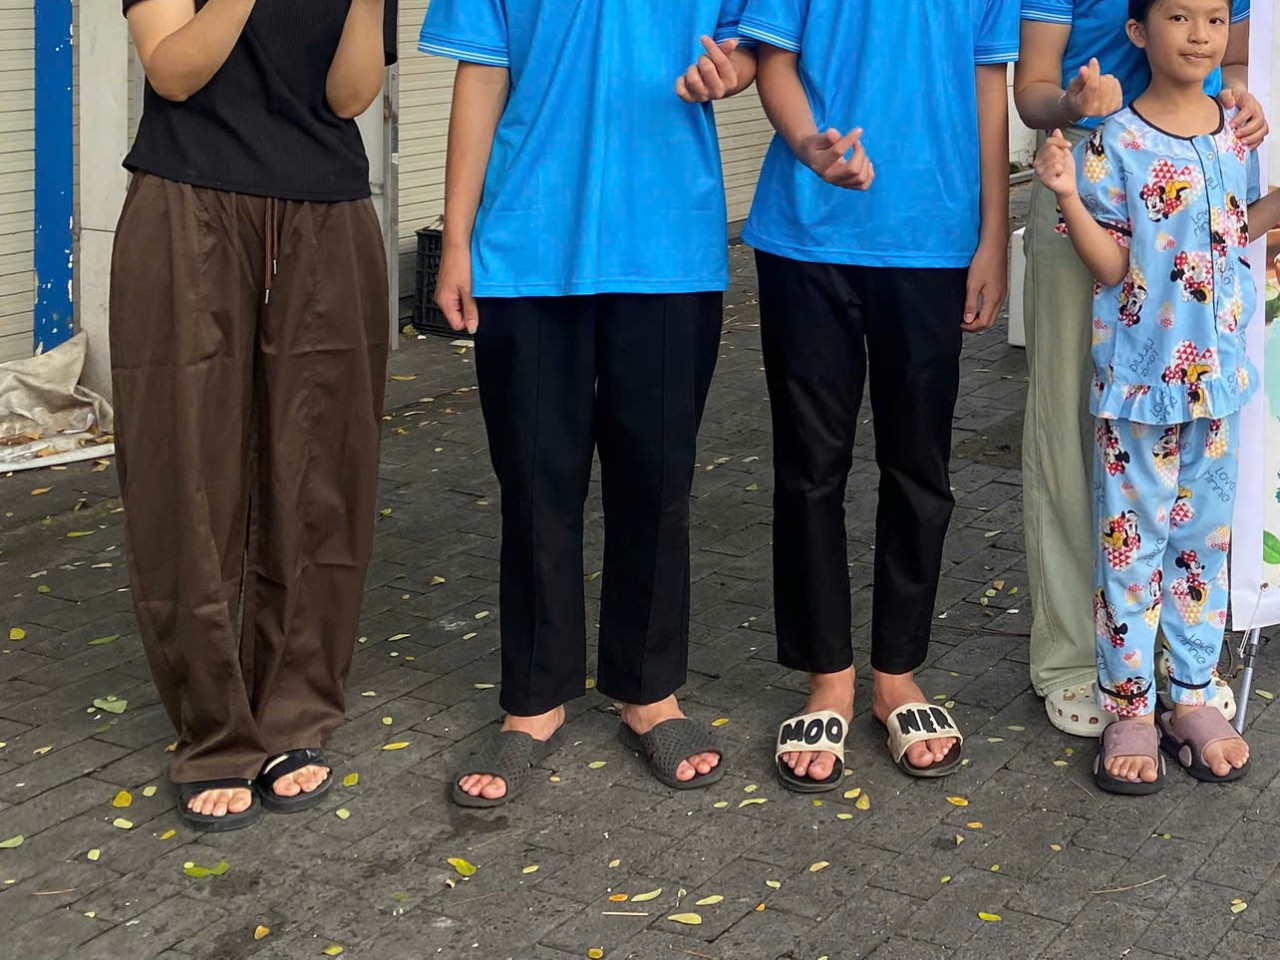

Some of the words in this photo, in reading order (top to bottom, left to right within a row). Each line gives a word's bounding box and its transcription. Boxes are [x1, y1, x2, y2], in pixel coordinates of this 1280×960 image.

[1215, 467, 1235, 491] Love
[1189, 634, 1214, 656] Love
[780, 717, 843, 745] MOO
